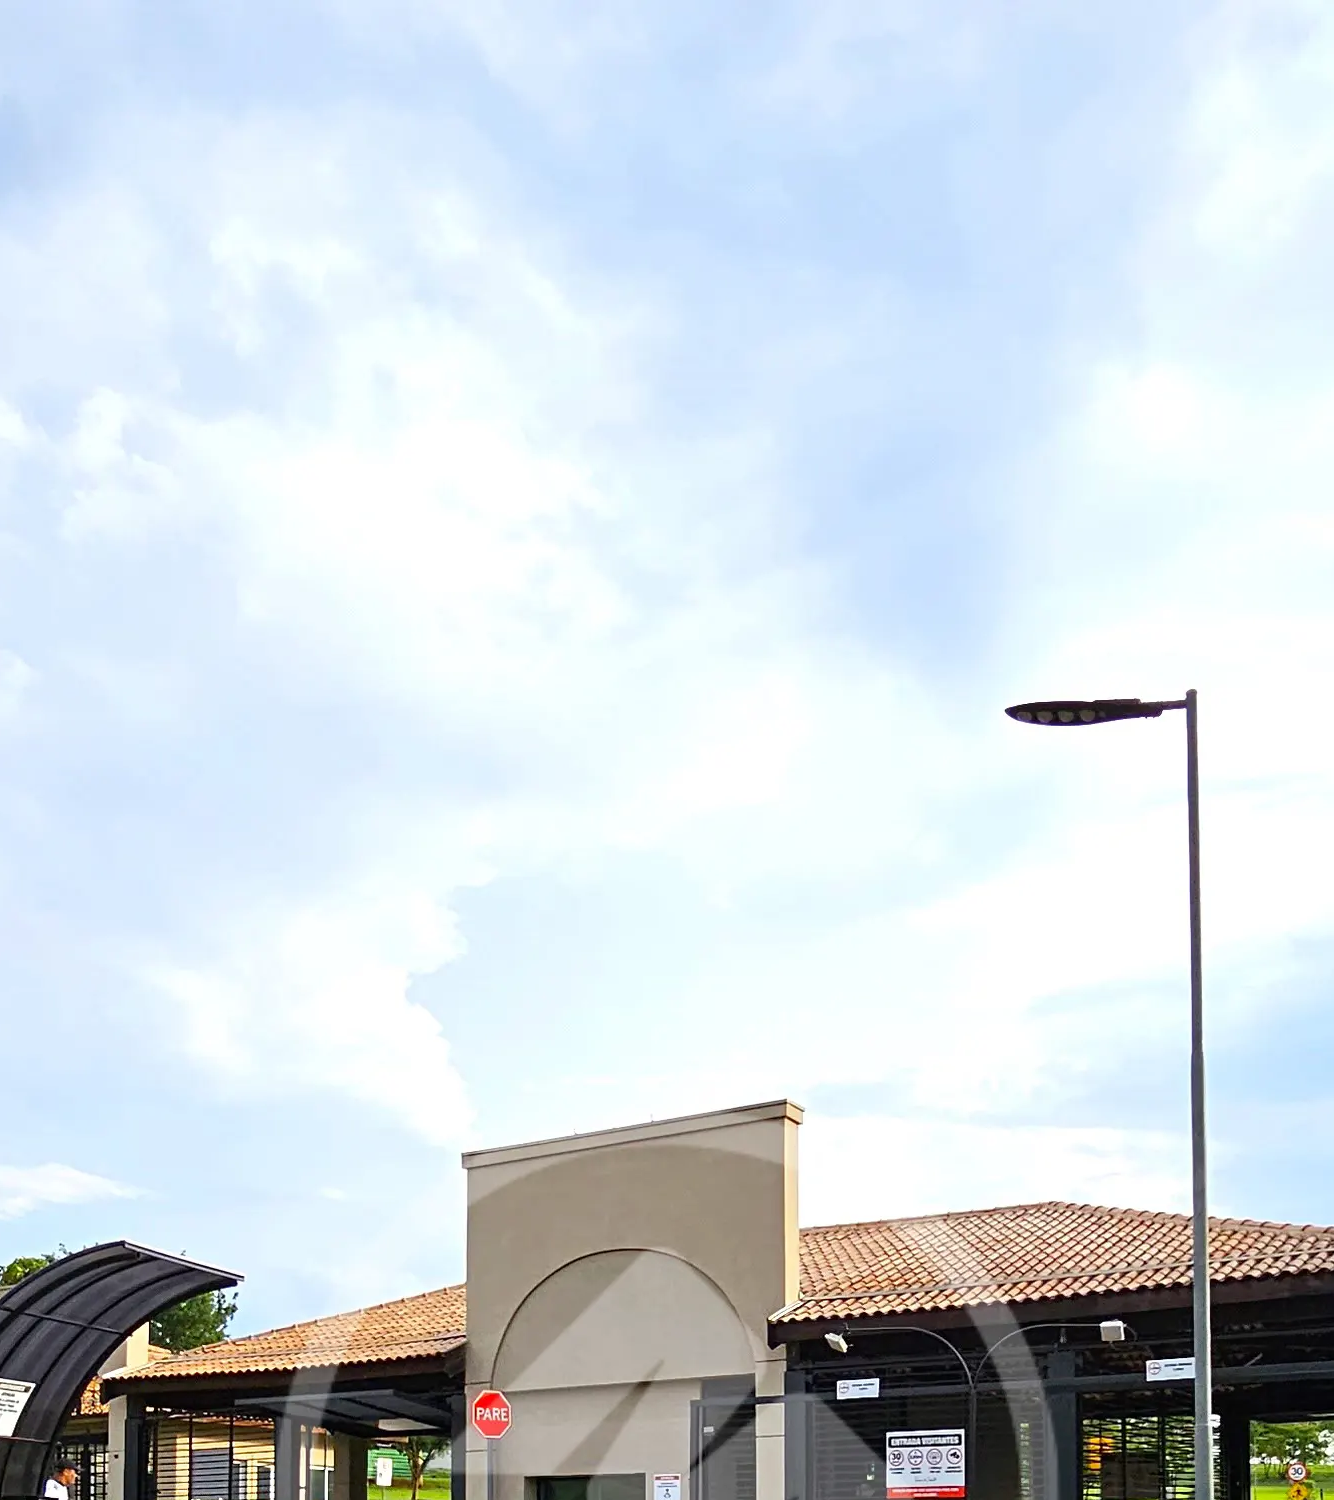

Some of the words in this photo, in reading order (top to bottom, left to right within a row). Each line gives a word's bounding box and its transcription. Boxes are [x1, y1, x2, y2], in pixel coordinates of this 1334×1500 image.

[476, 1406, 508, 1422] PARE
[890, 1437, 921, 1446] ENTRADA
[1291, 1467, 1304, 1476] 30
